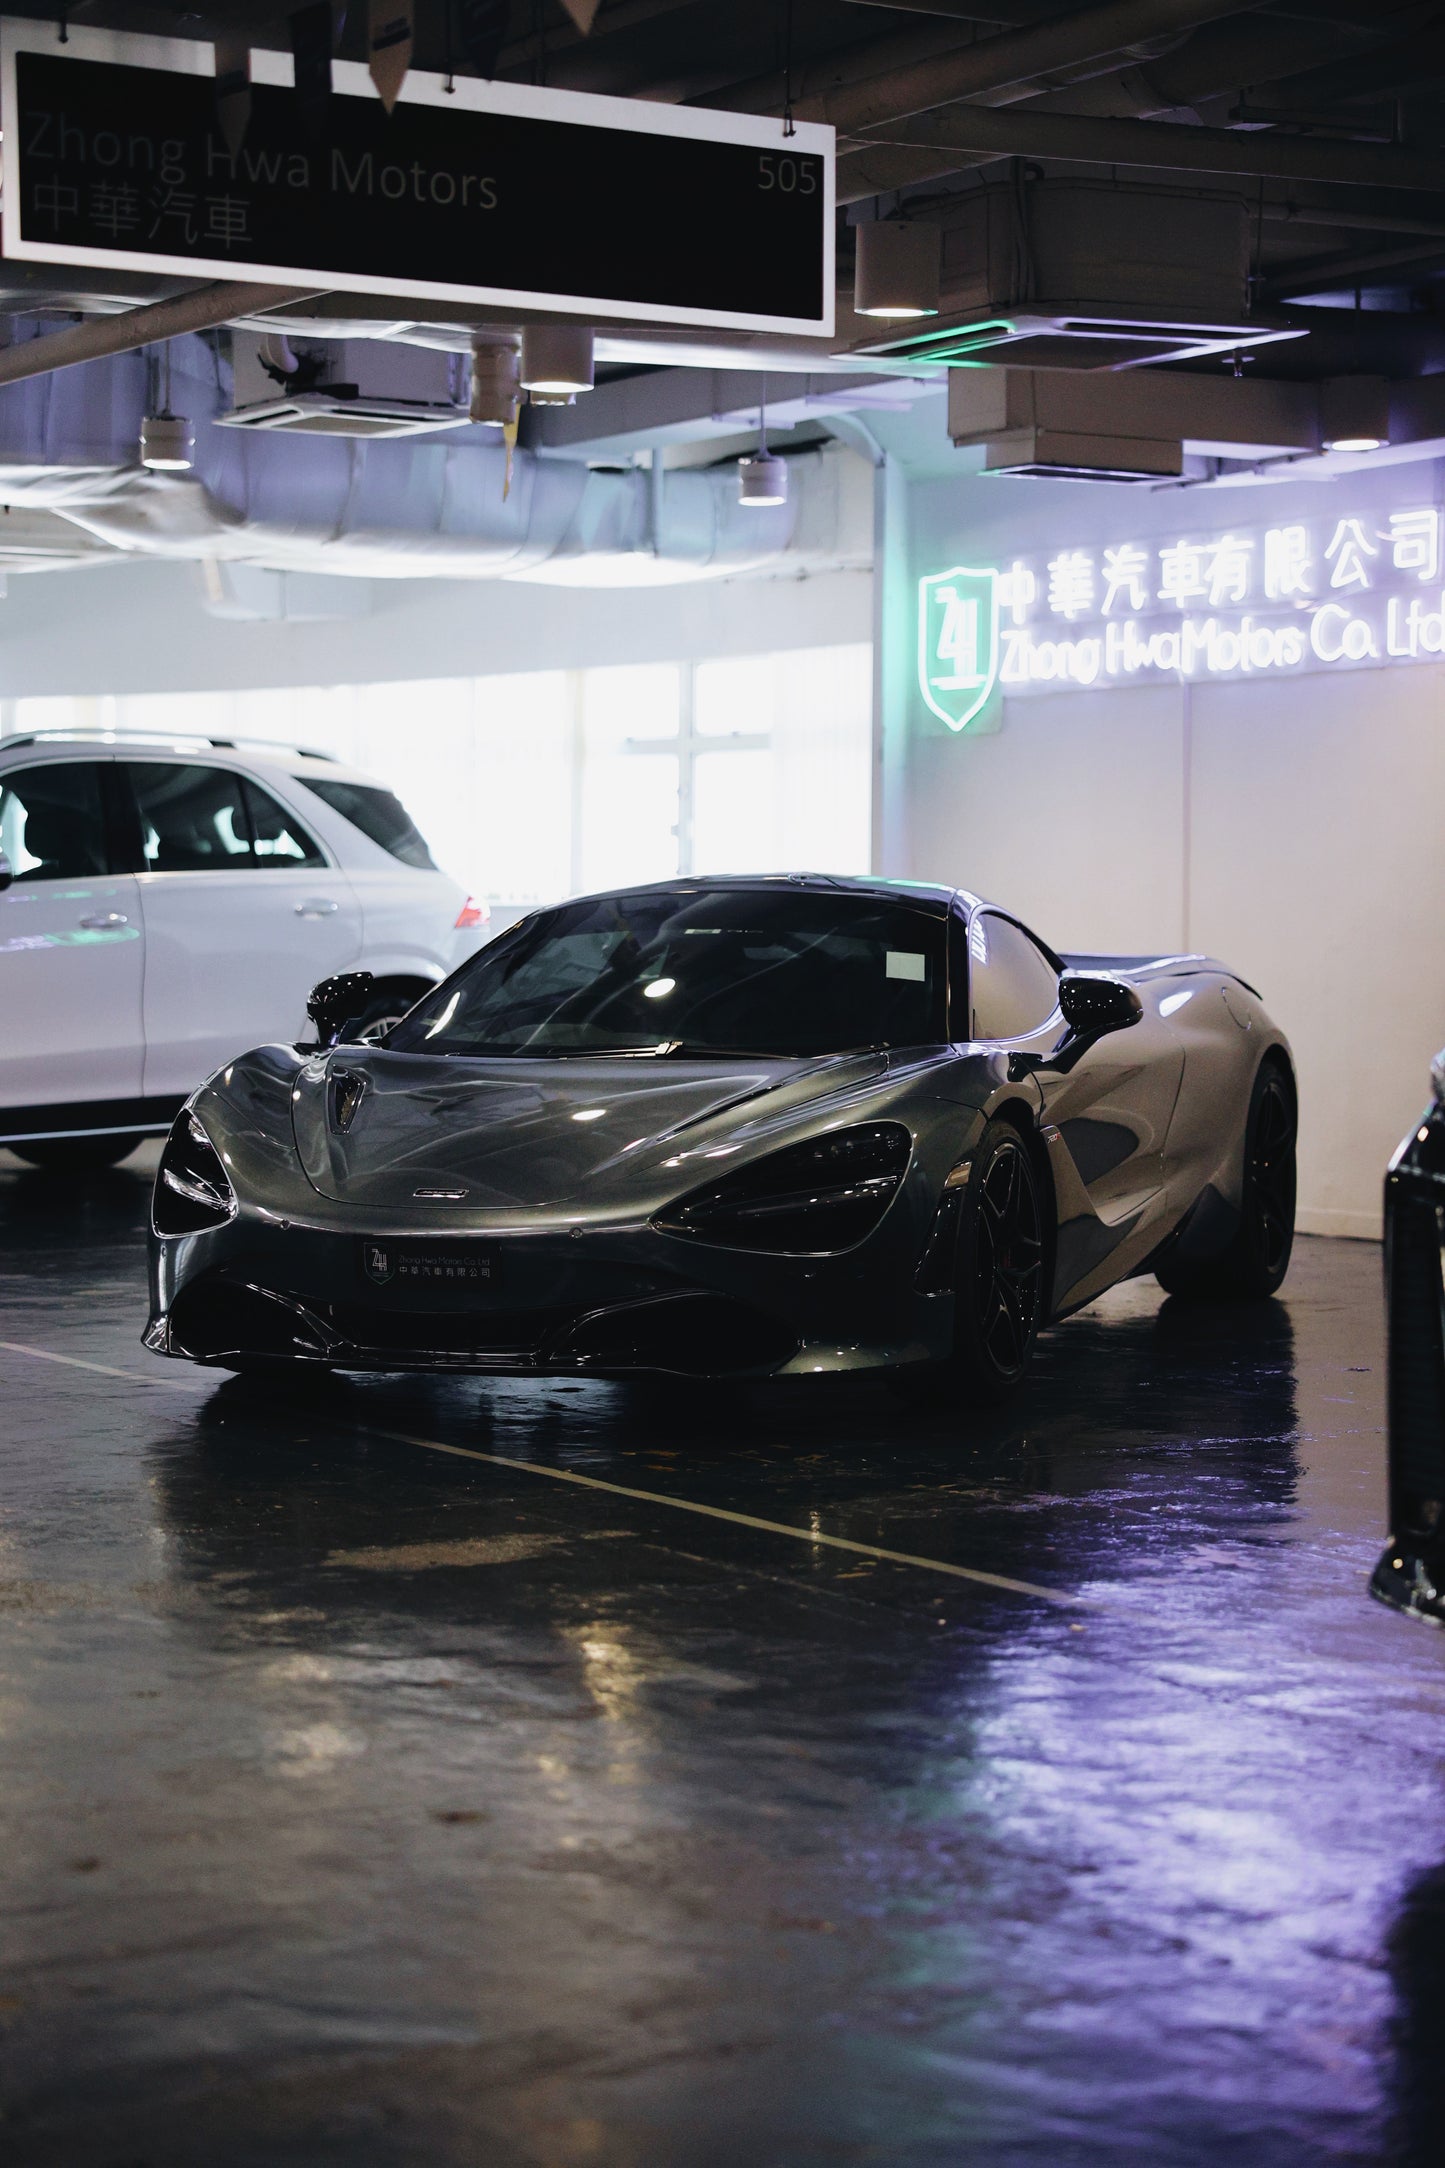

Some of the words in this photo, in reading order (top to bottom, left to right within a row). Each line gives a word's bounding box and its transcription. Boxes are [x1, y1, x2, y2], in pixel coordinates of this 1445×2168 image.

[26, 111, 186, 185] Zhong
[206, 133, 310, 188] Hwa
[331, 148, 499, 210] Motors
[758, 155, 817, 195] 505
[34, 171, 253, 249] 中華汽車
[998, 509, 1438, 625] 中華汽車有限公司
[1000, 629, 1101, 685] Zhong
[1105, 619, 1182, 675] Hwa
[1181, 615, 1305, 675] Motors
